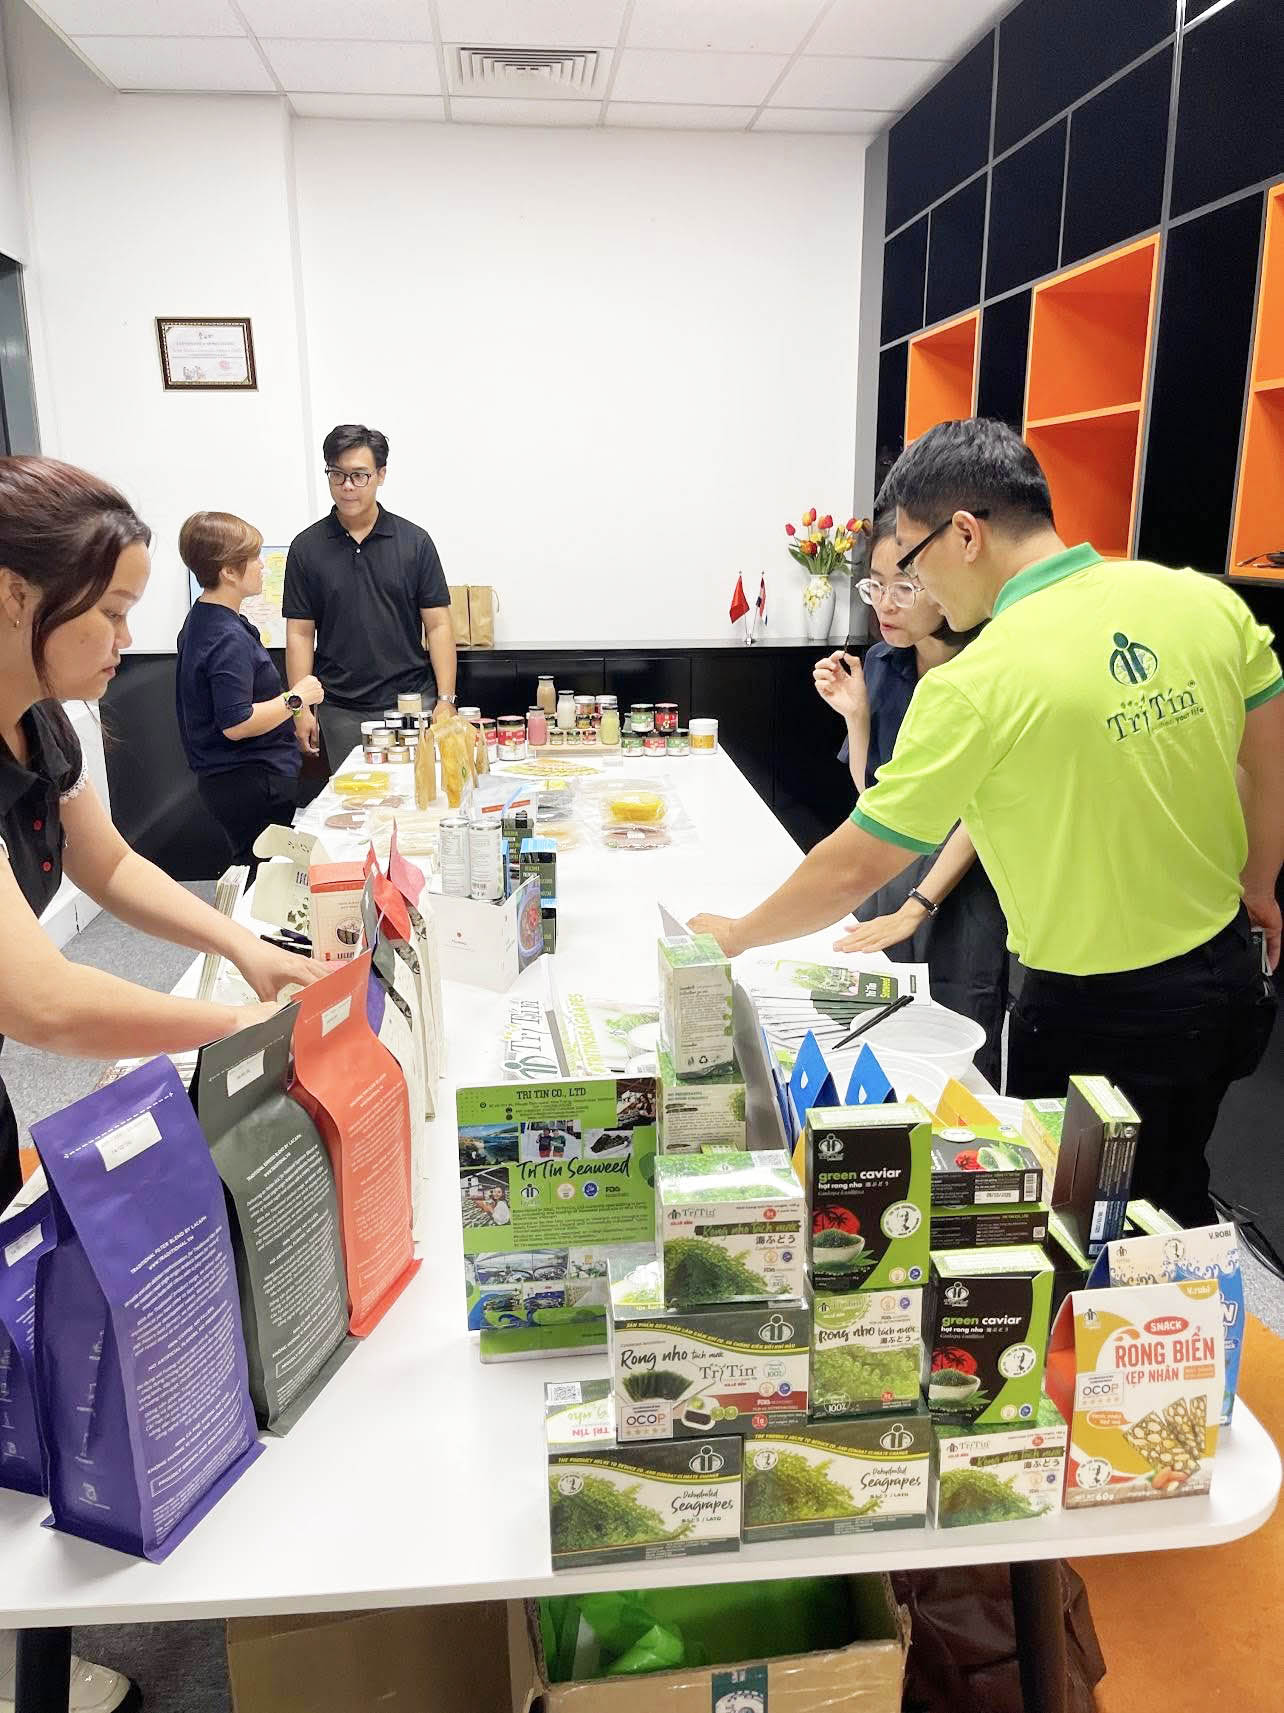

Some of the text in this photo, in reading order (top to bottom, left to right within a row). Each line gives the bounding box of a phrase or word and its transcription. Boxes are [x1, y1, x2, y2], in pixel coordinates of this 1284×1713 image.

[516, 1091, 532, 1100] TRI
[534, 1090, 549, 1099] TIN
[569, 1087, 586, 1097] LTD
[568, 1153, 631, 1179] Seaweed
[818, 1167, 901, 1184] green caviar
[1208, 1229, 1232, 1240] V.ROBI
[130, 1252, 155, 1274] TRADITIONAL
[168, 1230, 185, 1244] BLEND
[184, 1226, 192, 1234] BY
[942, 1314, 1022, 1327] green caviar
[1150, 1320, 1183, 1332] SNACK
[818, 1330, 849, 1344] Rong
[853, 1325, 875, 1338] nho
[1114, 1325, 1215, 1369] RONG BIỂN
[619, 1349, 657, 1370] Rong
[662, 1344, 688, 1362] nho
[1082, 1383, 1119, 1396] OCOP
[626, 1413, 667, 1426] OCOP
[860, 1472, 921, 1493] Seagrapes
[671, 1496, 734, 1517] Seagrapes
